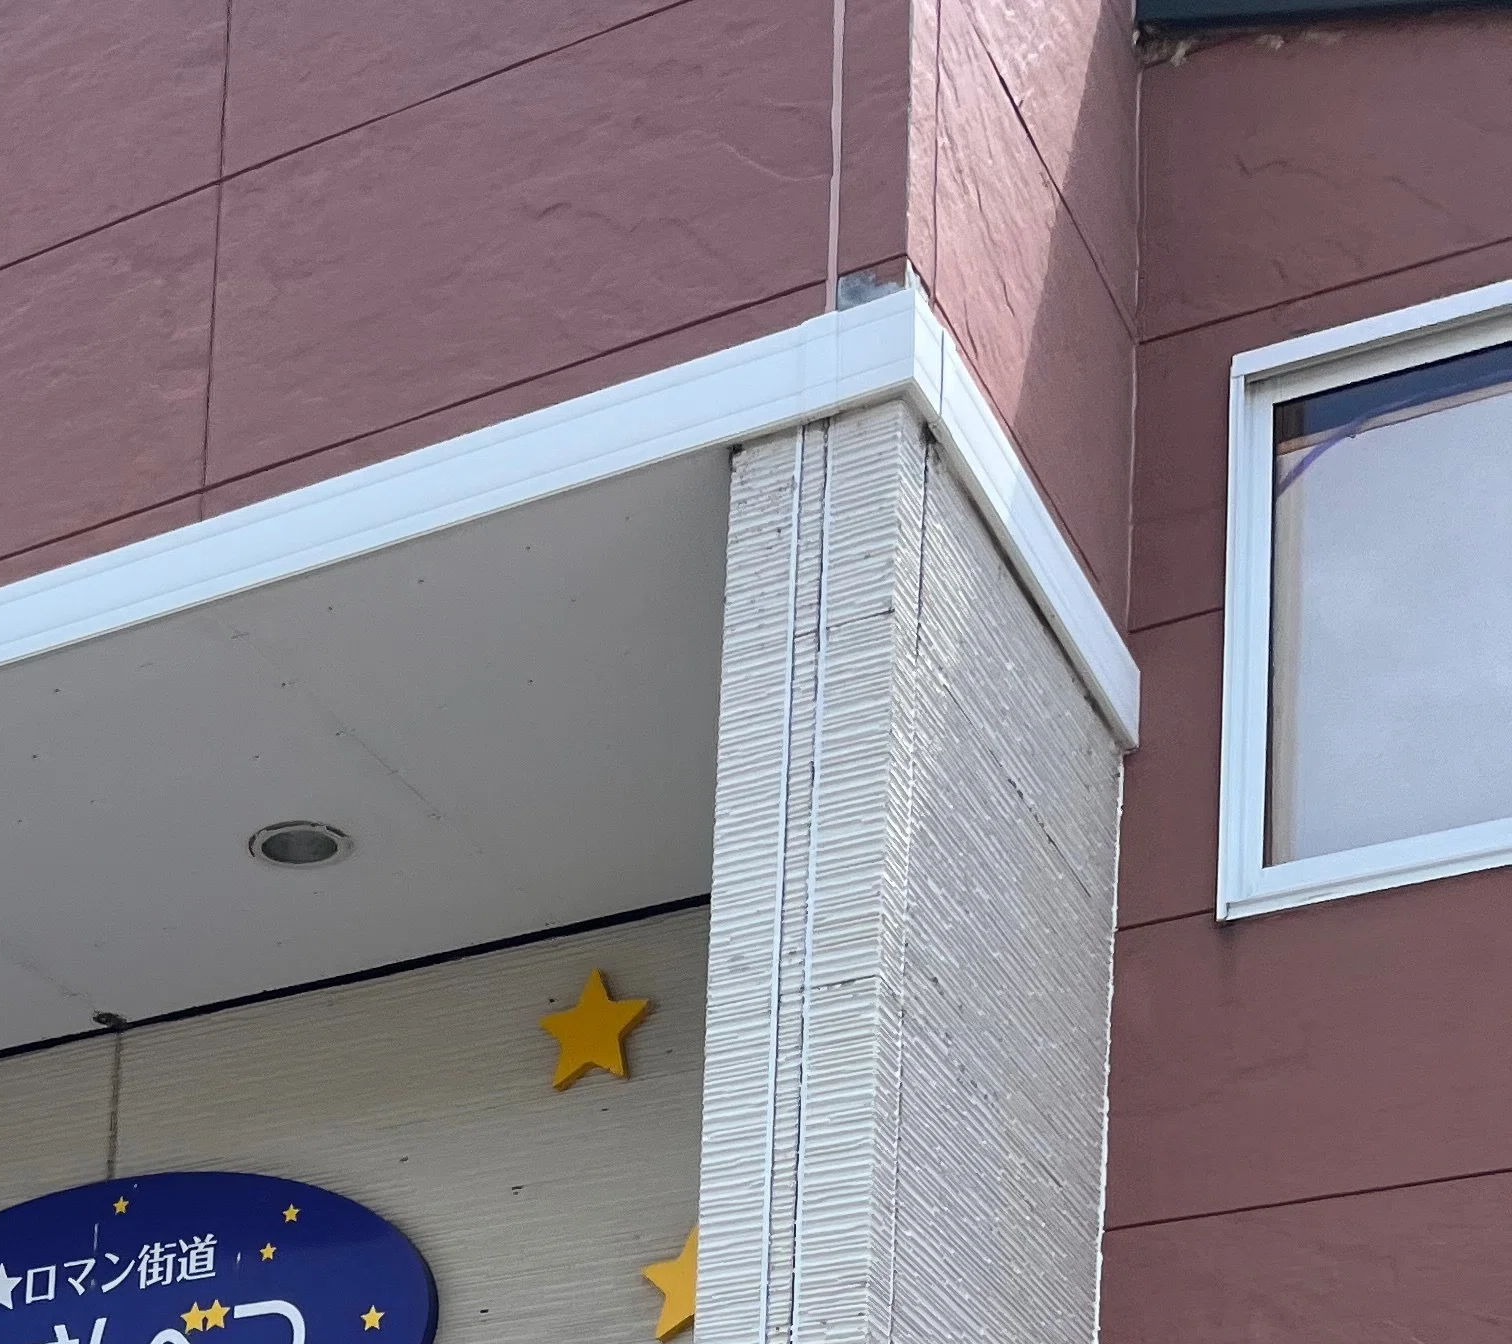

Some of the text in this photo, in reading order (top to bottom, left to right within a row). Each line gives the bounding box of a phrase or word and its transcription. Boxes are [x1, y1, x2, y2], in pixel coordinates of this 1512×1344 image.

[25, 1232, 218, 1304] ロマン街道
